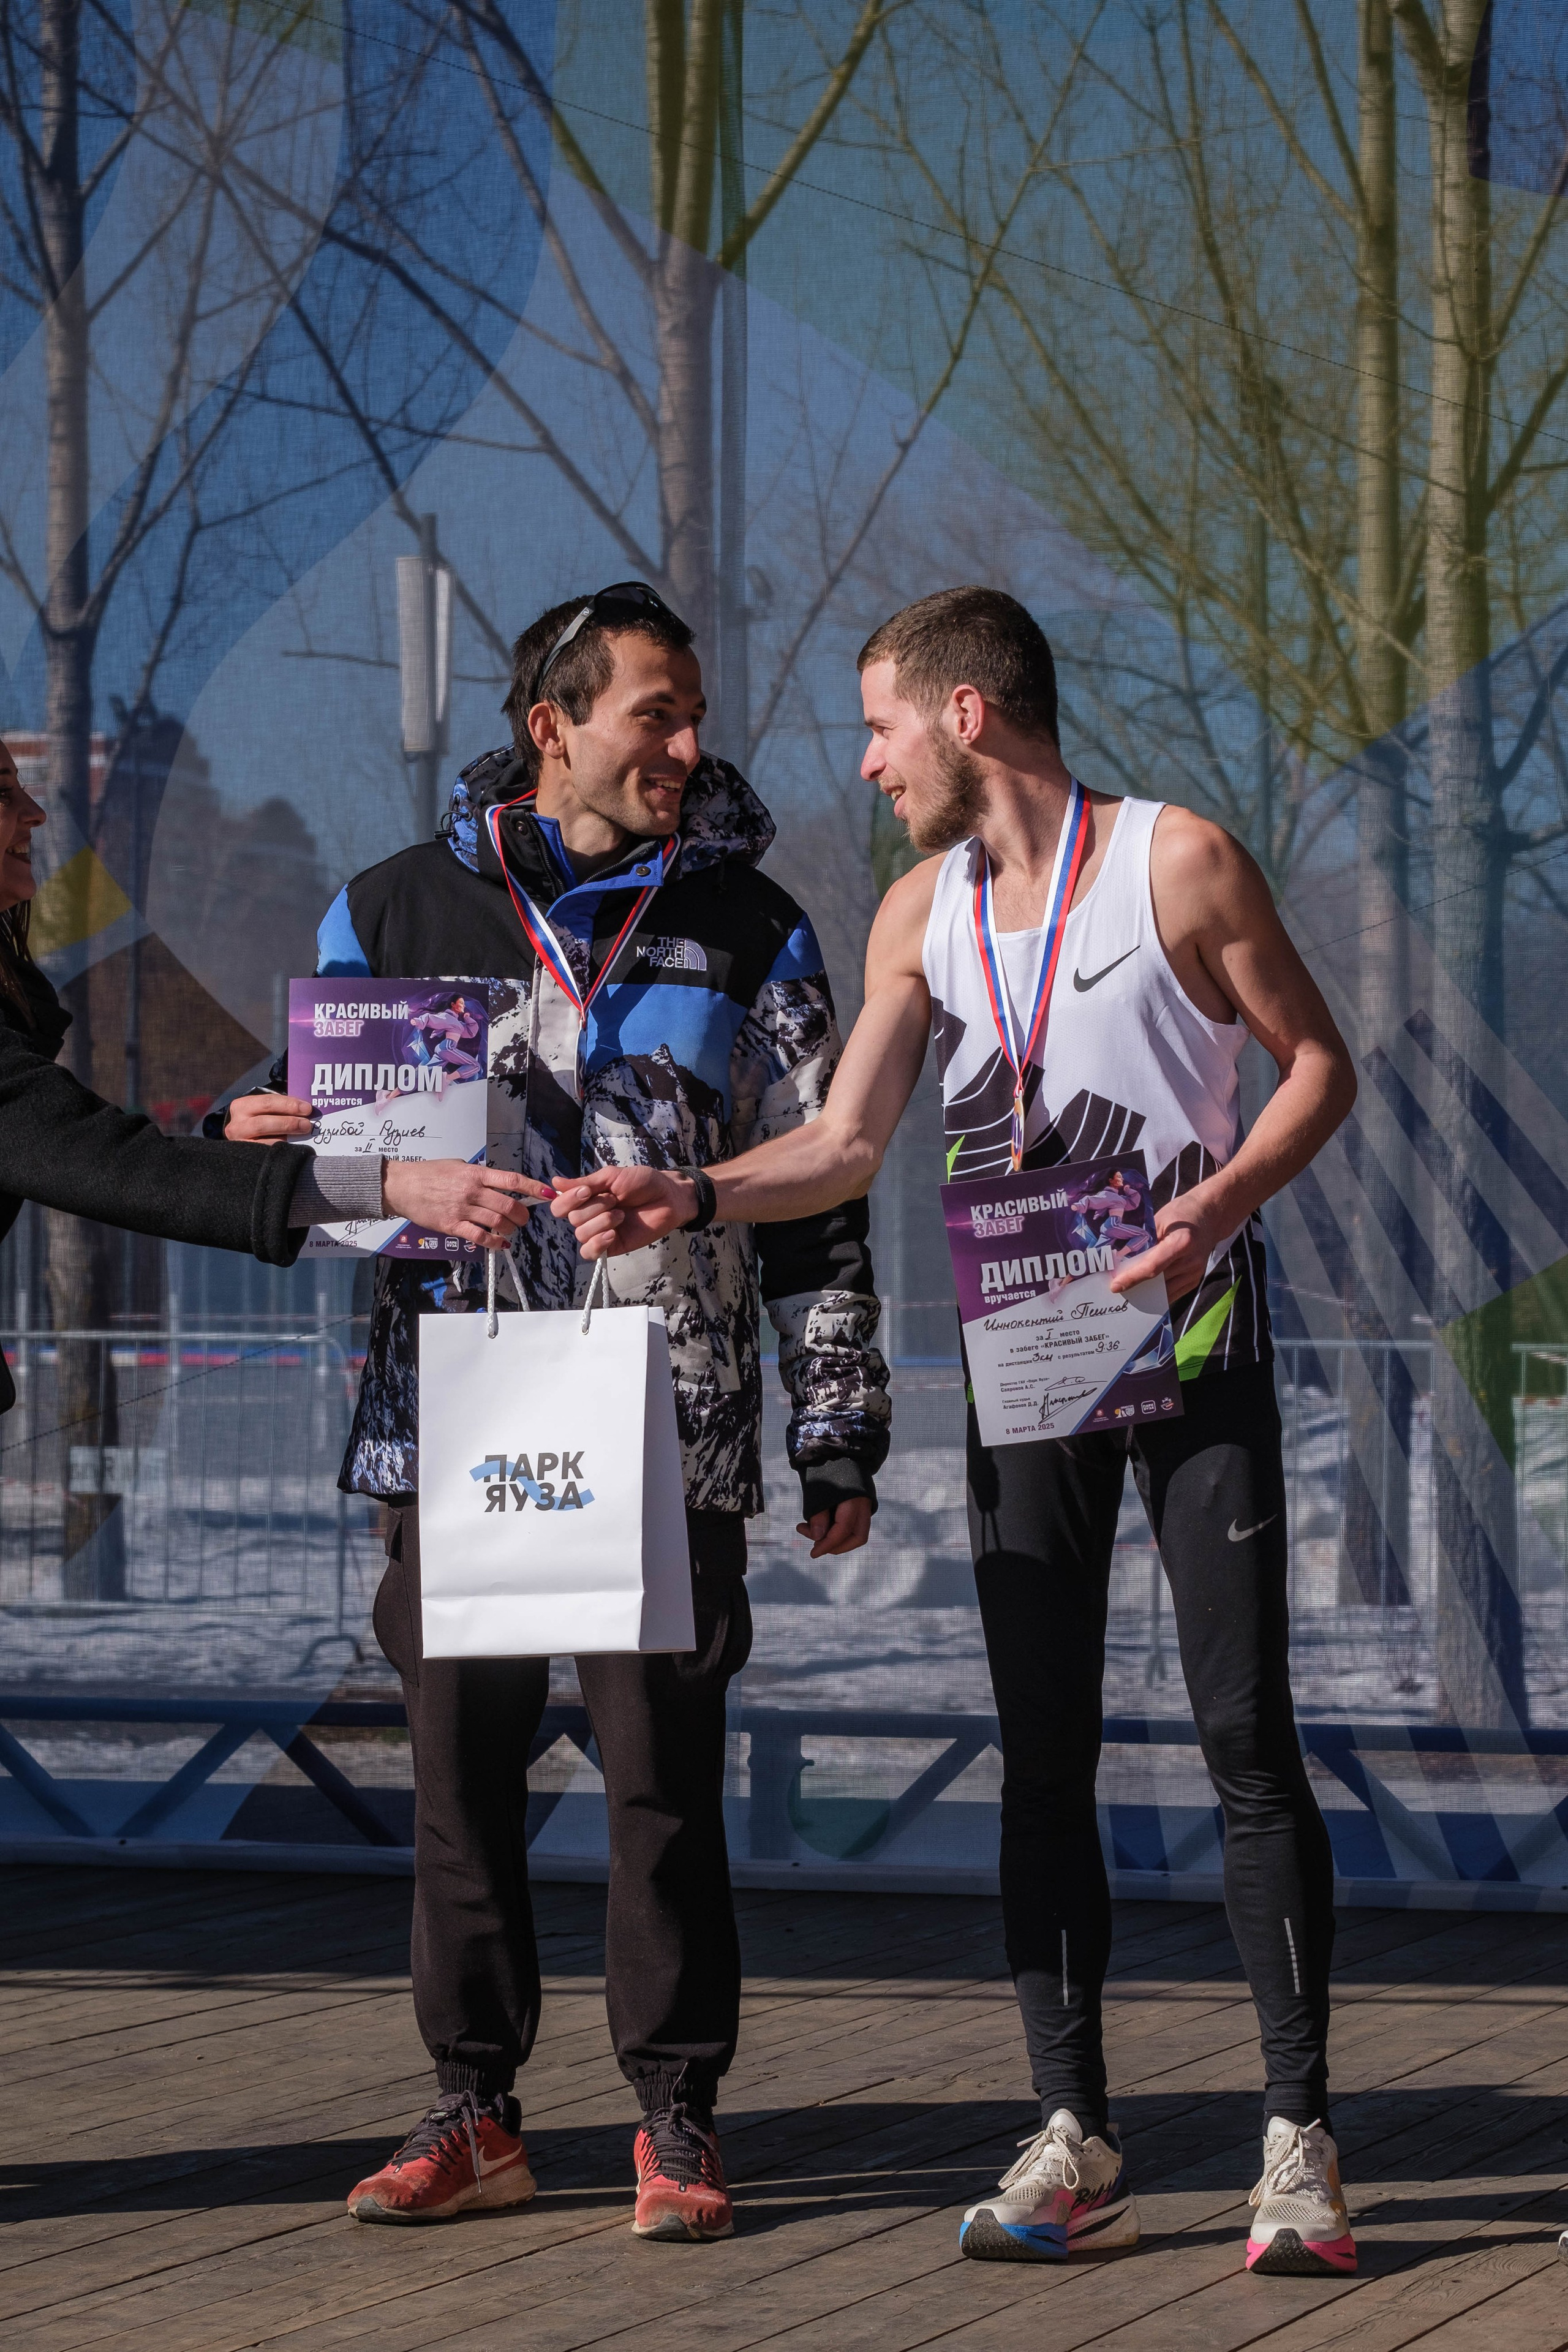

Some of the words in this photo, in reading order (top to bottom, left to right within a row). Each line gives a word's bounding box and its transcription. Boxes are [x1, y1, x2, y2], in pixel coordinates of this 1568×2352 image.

[636, 946, 684, 957] NORTH
[657, 937, 684, 948] THE
[649, 957, 684, 968] FACE
[314, 1000, 409, 1020] КРАСИВЫЙ
[314, 1020, 364, 1036] ЗАБЕГ
[311, 1063, 443, 1096] ДИПЛОМ
[312, 1098, 363, 1107] вручается
[970, 1188, 1069, 1222] КРАСИВЫЙ
[974, 1216, 1024, 1237] ЗАБЕГ
[981, 1245, 1115, 1294] ДИПЛОМ
[984, 1289, 1036, 1305] вручается
[984, 1310, 1064, 1331] Иннокентий
[1060, 1329, 1080, 1338] место
[1016, 1344, 1039, 1353] забеге
[1041, 1336, 1083, 1349] «КРАСИВЫЙ
[1084, 1333, 1110, 1343] ЗАБЕГ»
[1062, 1350, 1095, 1360] результатом
[1012, 1425, 1036, 1434] МАРТА
[1038, 1422, 1055, 1431] 2025
[484, 1451, 585, 1483] ПАРК
[484, 1481, 584, 1513] ЯУЗА
